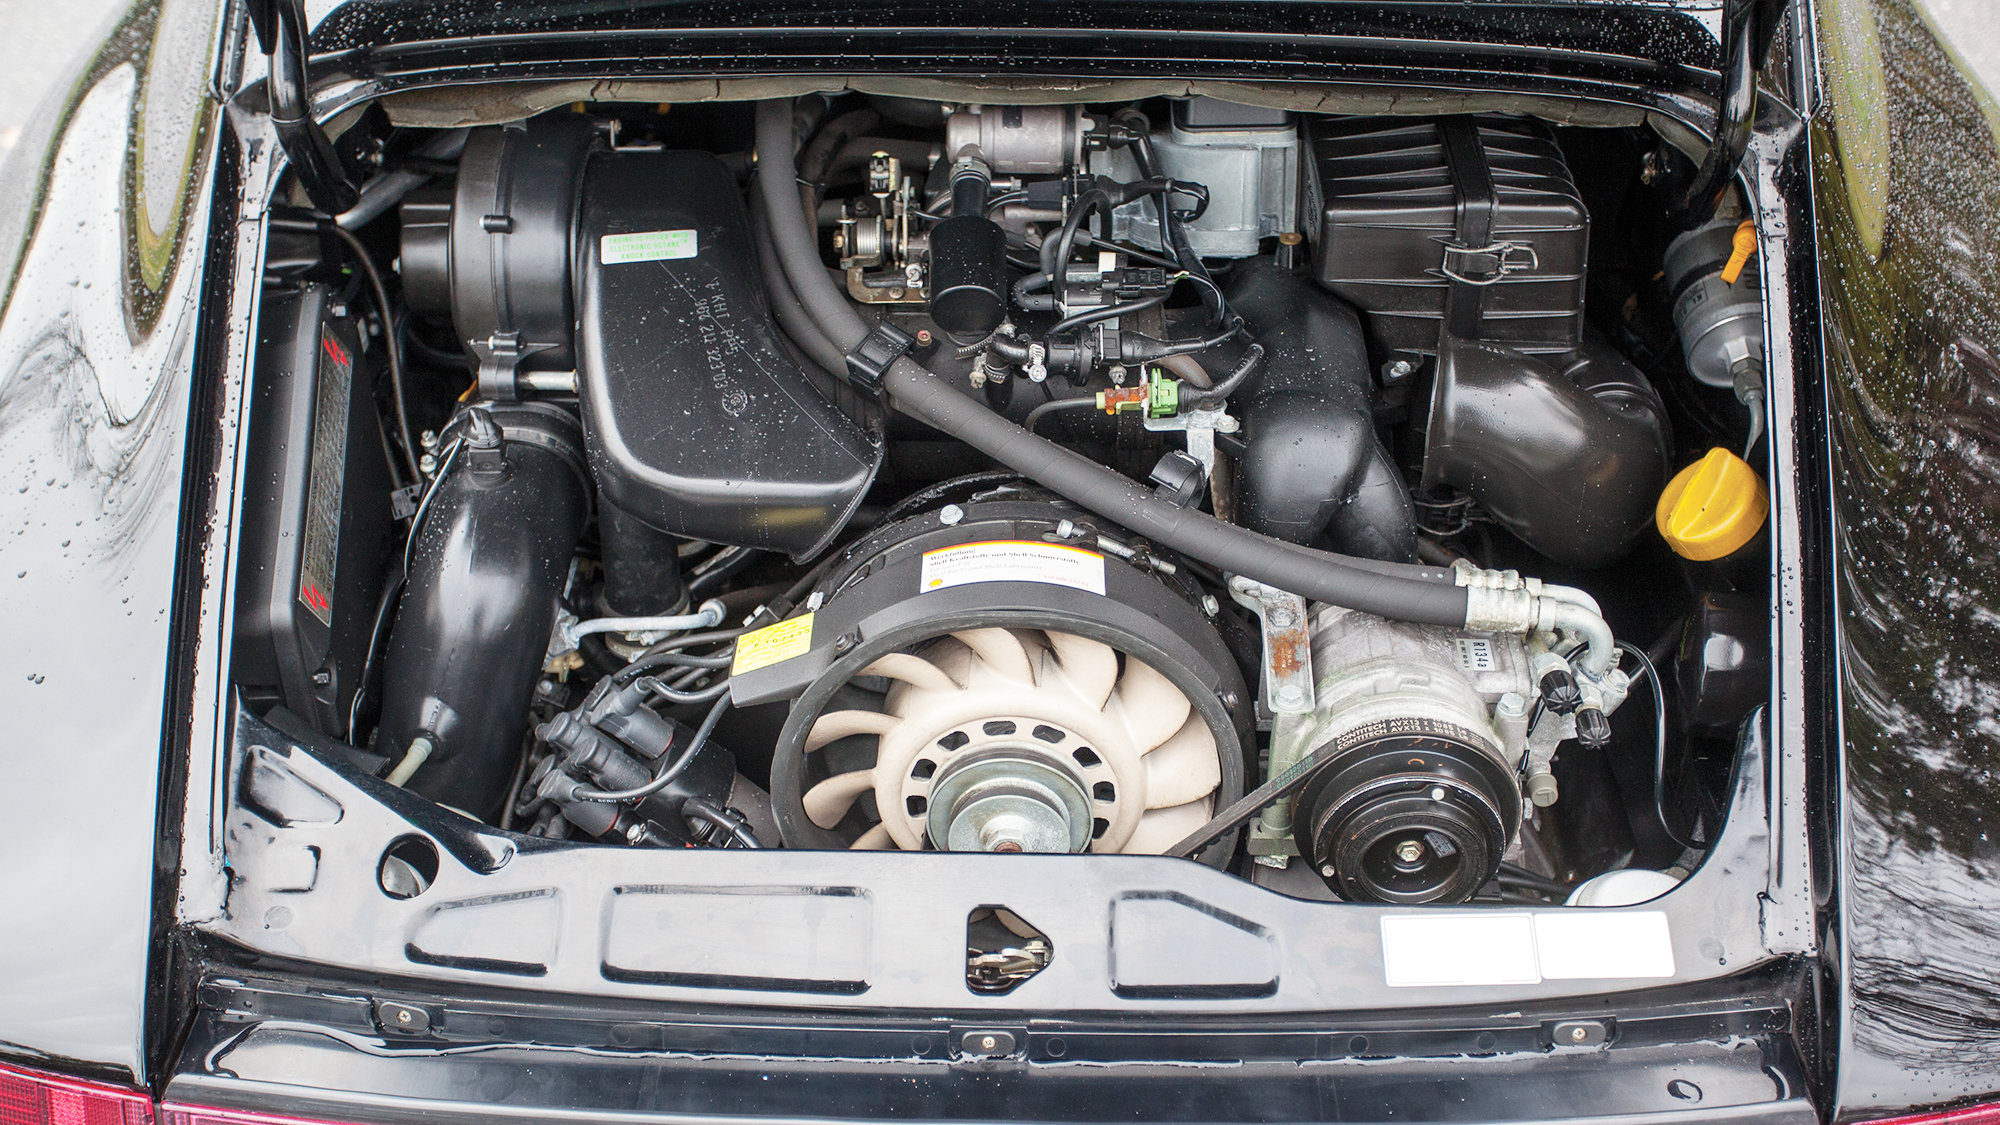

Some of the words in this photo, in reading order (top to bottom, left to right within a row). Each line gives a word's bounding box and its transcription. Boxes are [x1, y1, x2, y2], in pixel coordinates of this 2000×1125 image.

[610, 242, 652, 252] ELECTRONIC
[621, 252, 644, 260] KNOCK
[646, 249, 677, 259] CONTROL
[706, 346, 726, 371] 323
[712, 371, 729, 389] 03
[1472, 641, 1489, 668] R134a
[1336, 722, 1386, 745] CONTITECH
[1389, 719, 1420, 728] AVX13
[1337, 729, 1388, 750] CONTITECH
[1390, 725, 1421, 733] AVX13
